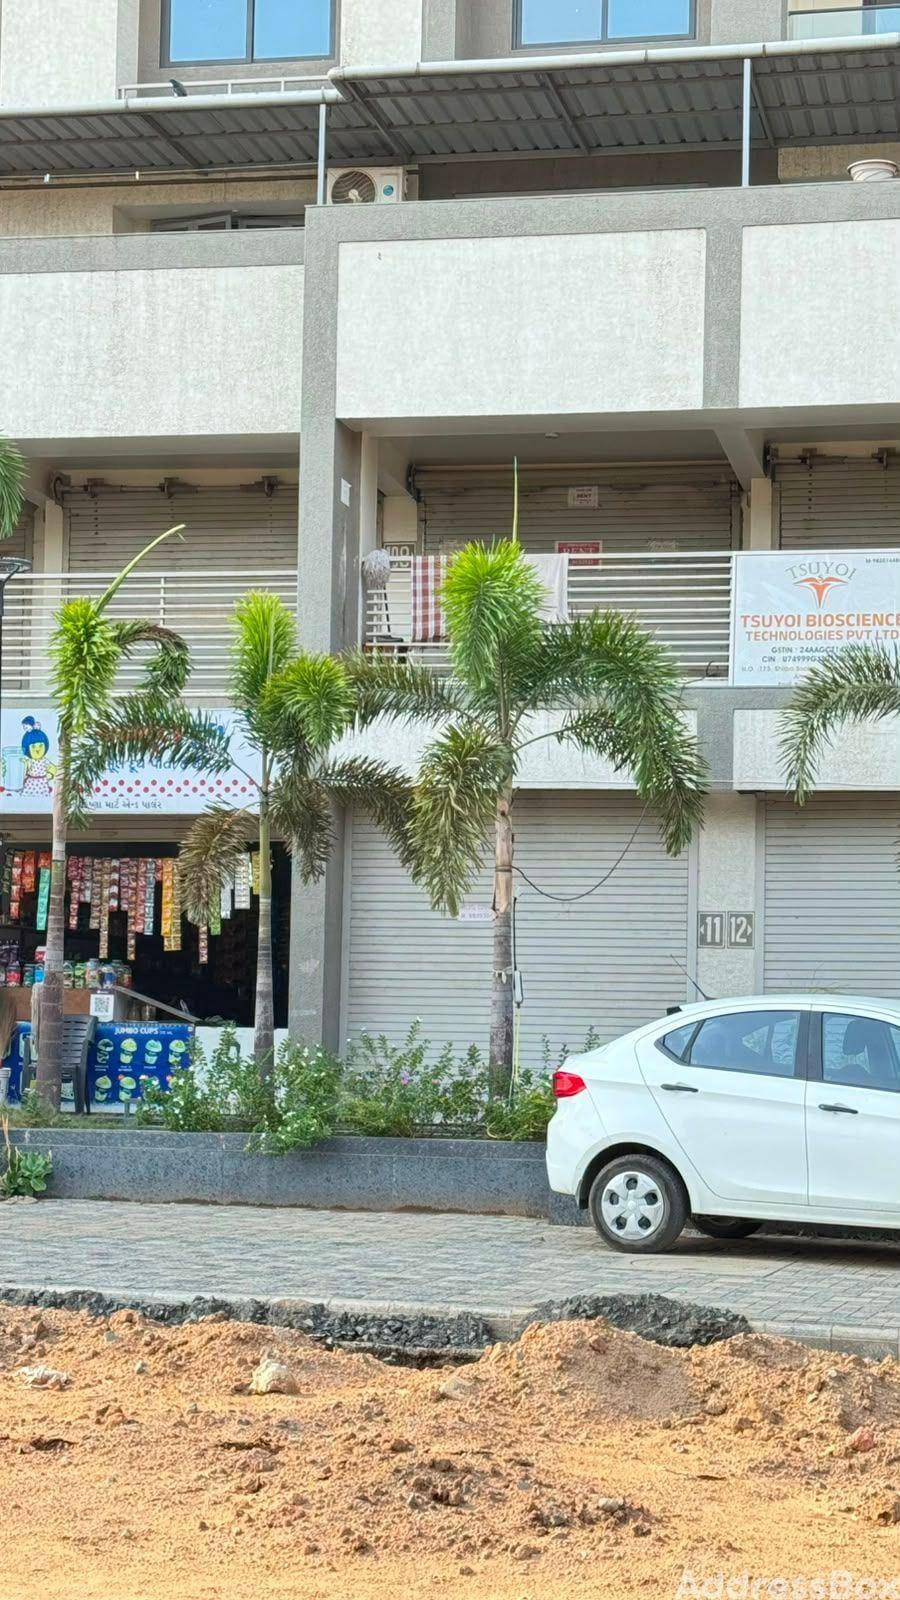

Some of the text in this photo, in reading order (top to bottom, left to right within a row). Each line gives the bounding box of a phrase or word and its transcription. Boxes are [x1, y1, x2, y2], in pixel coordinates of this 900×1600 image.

[785, 561, 857, 581] TSUYOI
[740, 614, 801, 628] TSUYOI
[746, 630, 843, 642] TECHNOLOGIES
[847, 629, 872, 641] PVT
[771, 646, 793, 654] GSTIN
[761, 655, 776, 663] CIN
[705, 916, 748, 943] 11 12
[140, 1026, 159, 1035] CUPS
